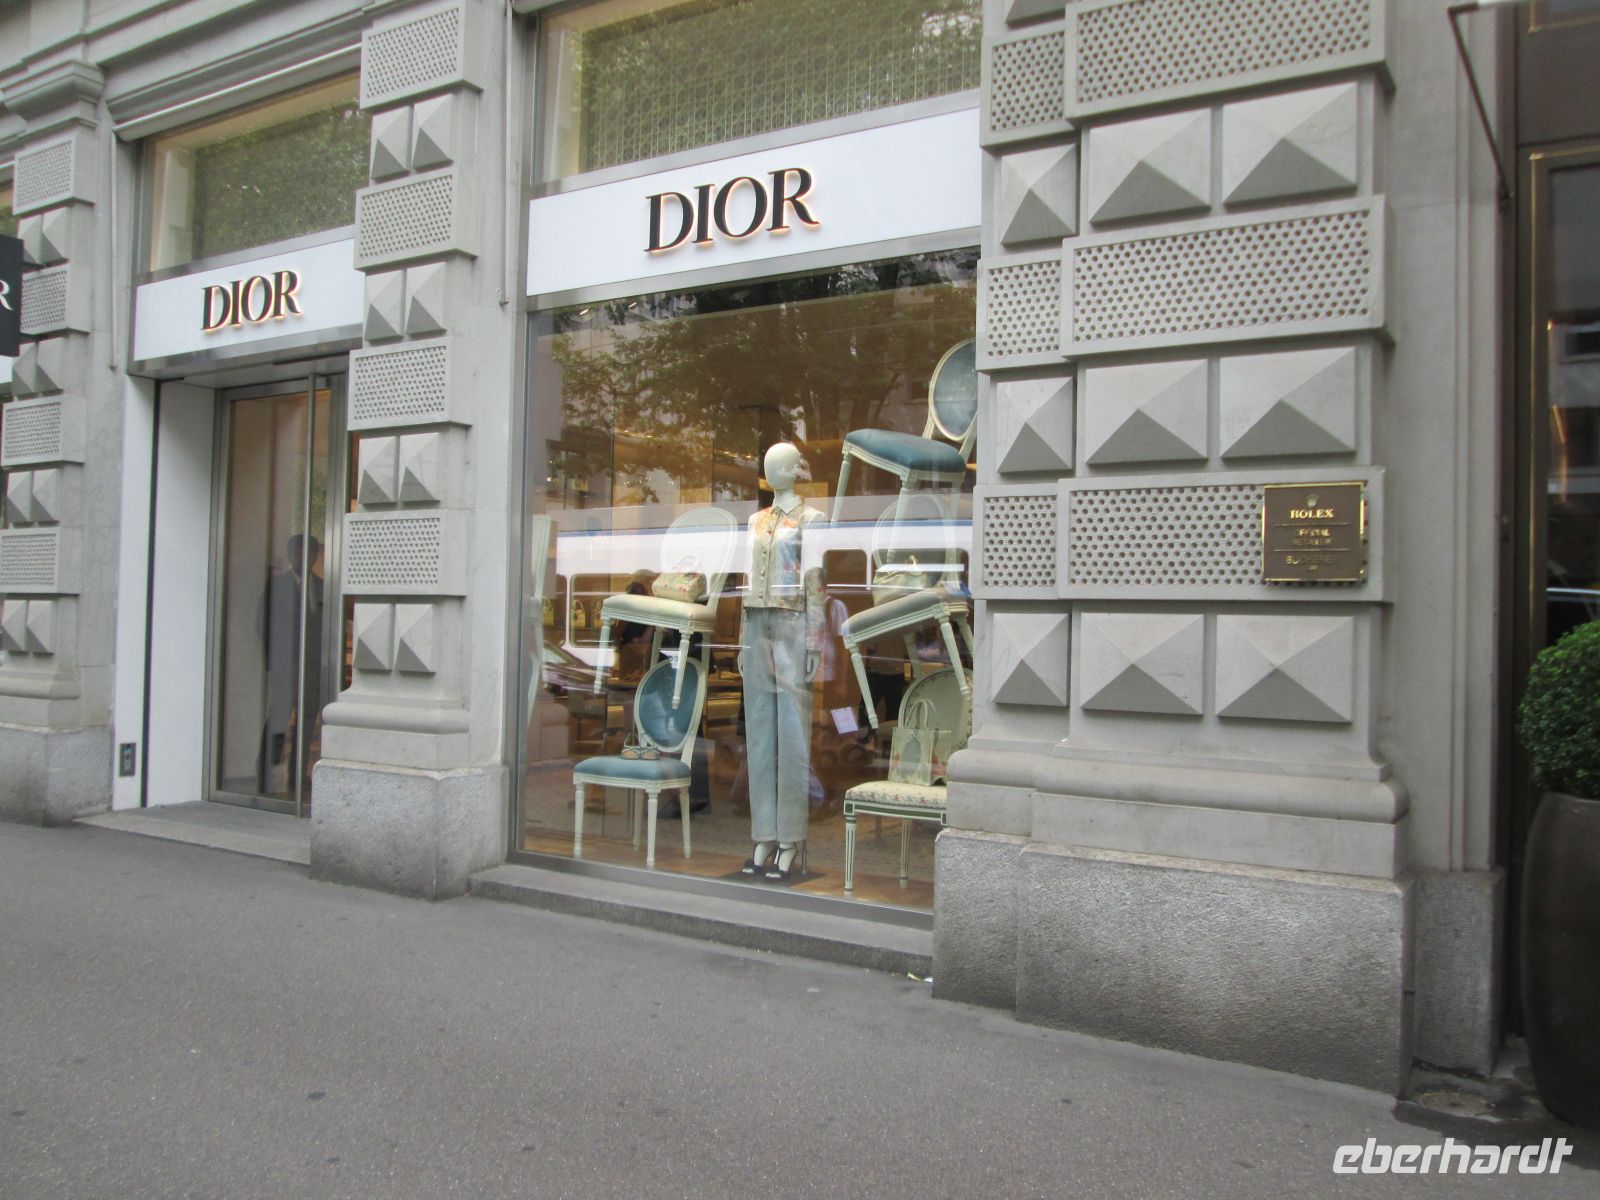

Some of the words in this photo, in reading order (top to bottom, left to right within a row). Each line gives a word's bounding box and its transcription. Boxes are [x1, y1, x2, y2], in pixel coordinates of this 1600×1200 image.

[643, 167, 820, 252] DIOR
[200, 270, 301, 331] DIOR
[1290, 508, 1334, 519] ROLEX
